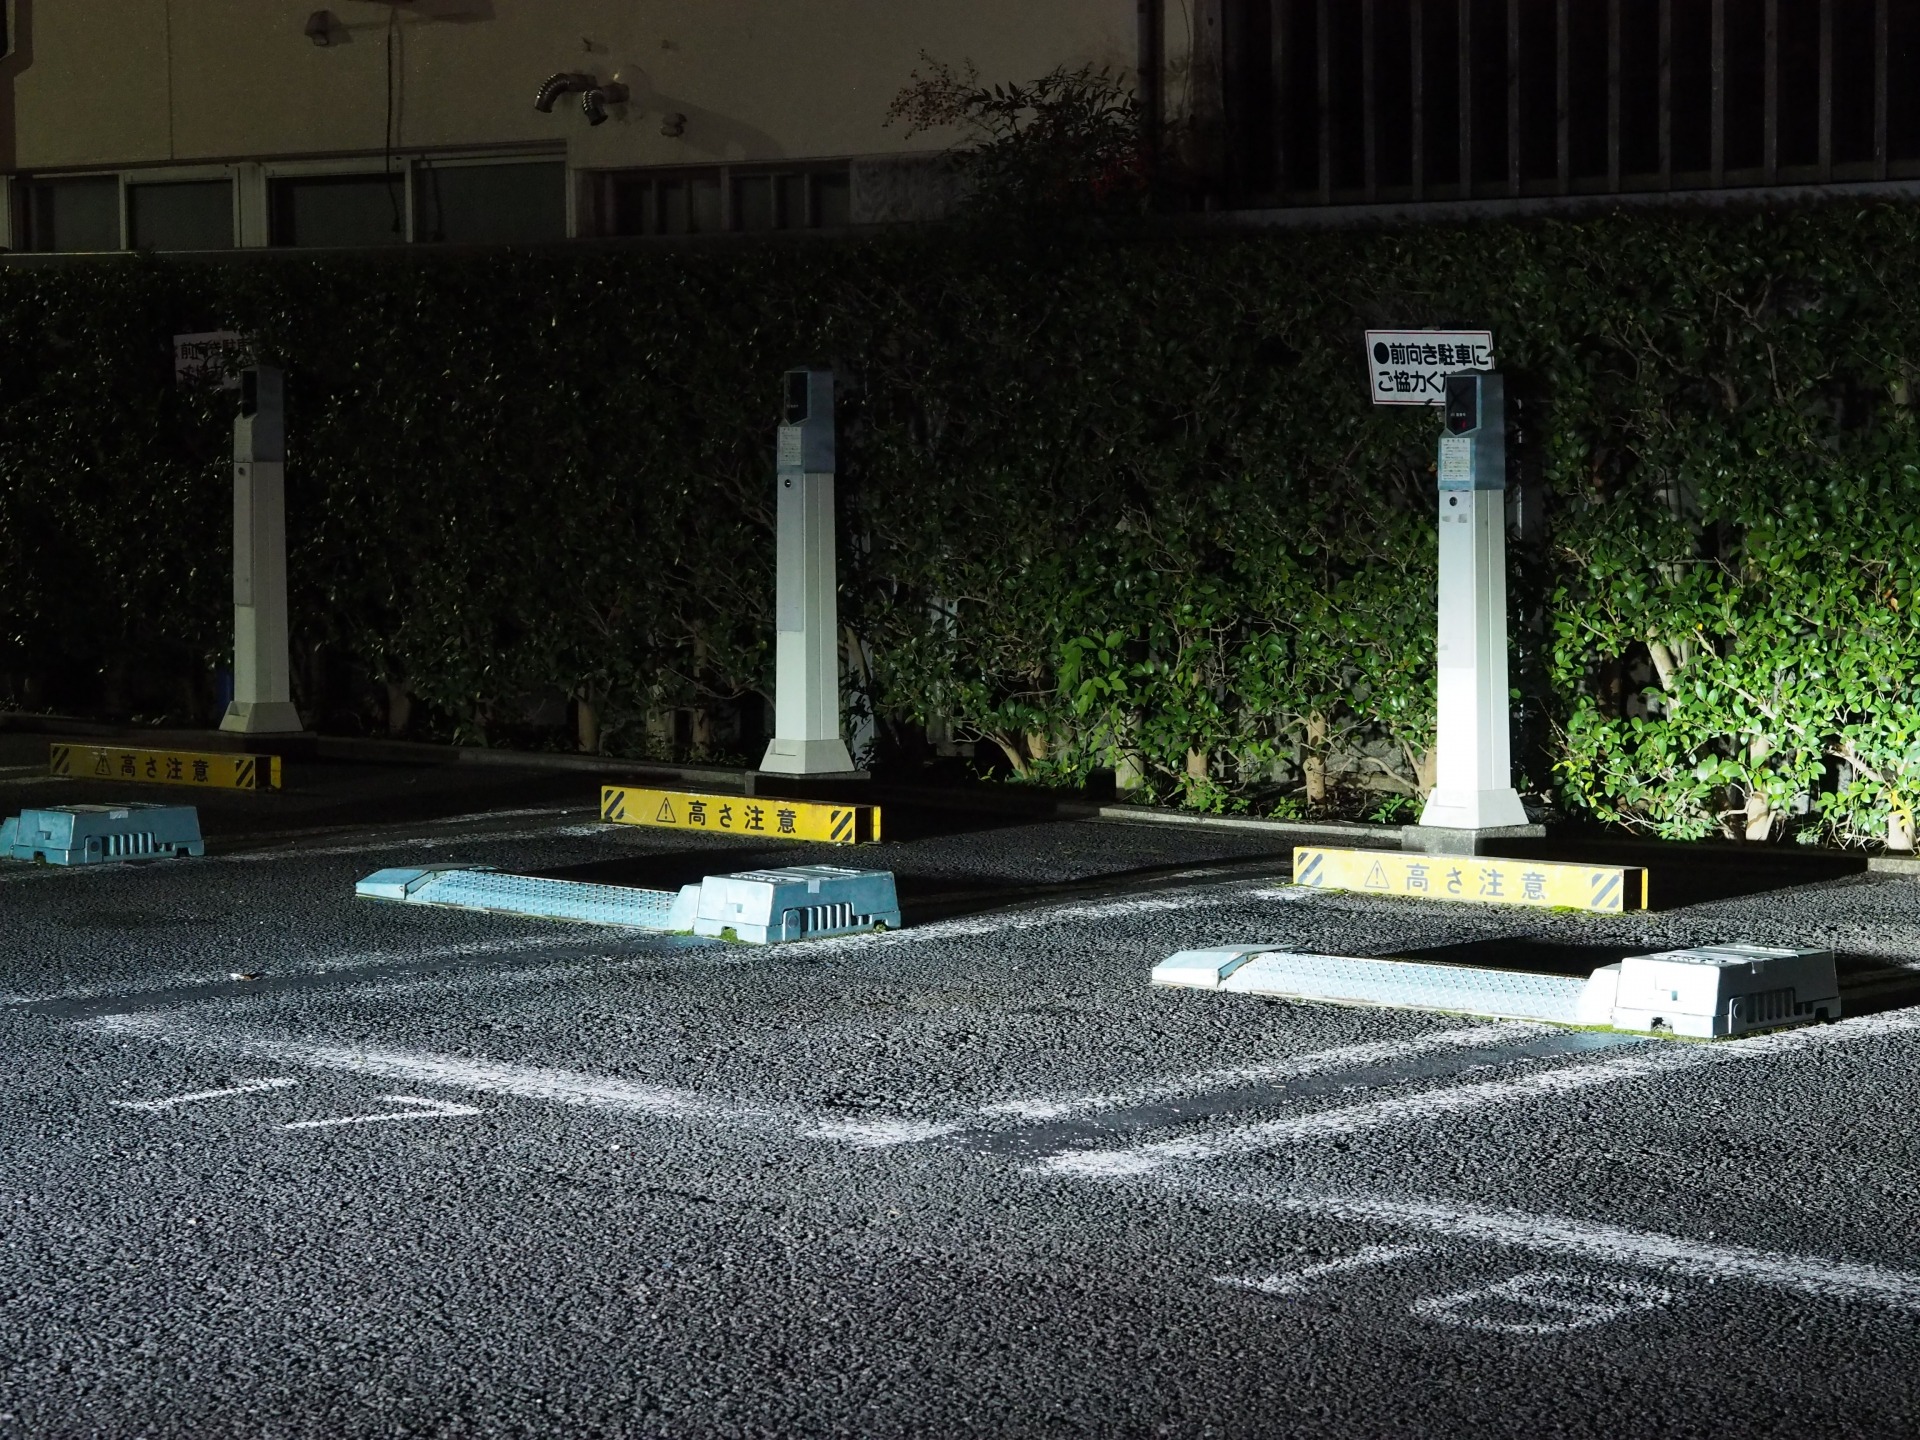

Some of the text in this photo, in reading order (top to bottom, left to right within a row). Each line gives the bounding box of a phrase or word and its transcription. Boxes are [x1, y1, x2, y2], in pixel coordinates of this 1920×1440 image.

[1389, 343, 1489, 366] 前向き駐車に
[120, 753, 209, 782] 高さ注意
[688, 800, 796, 834] 高さ注意
[1406, 863, 1547, 900] 高さ注意
